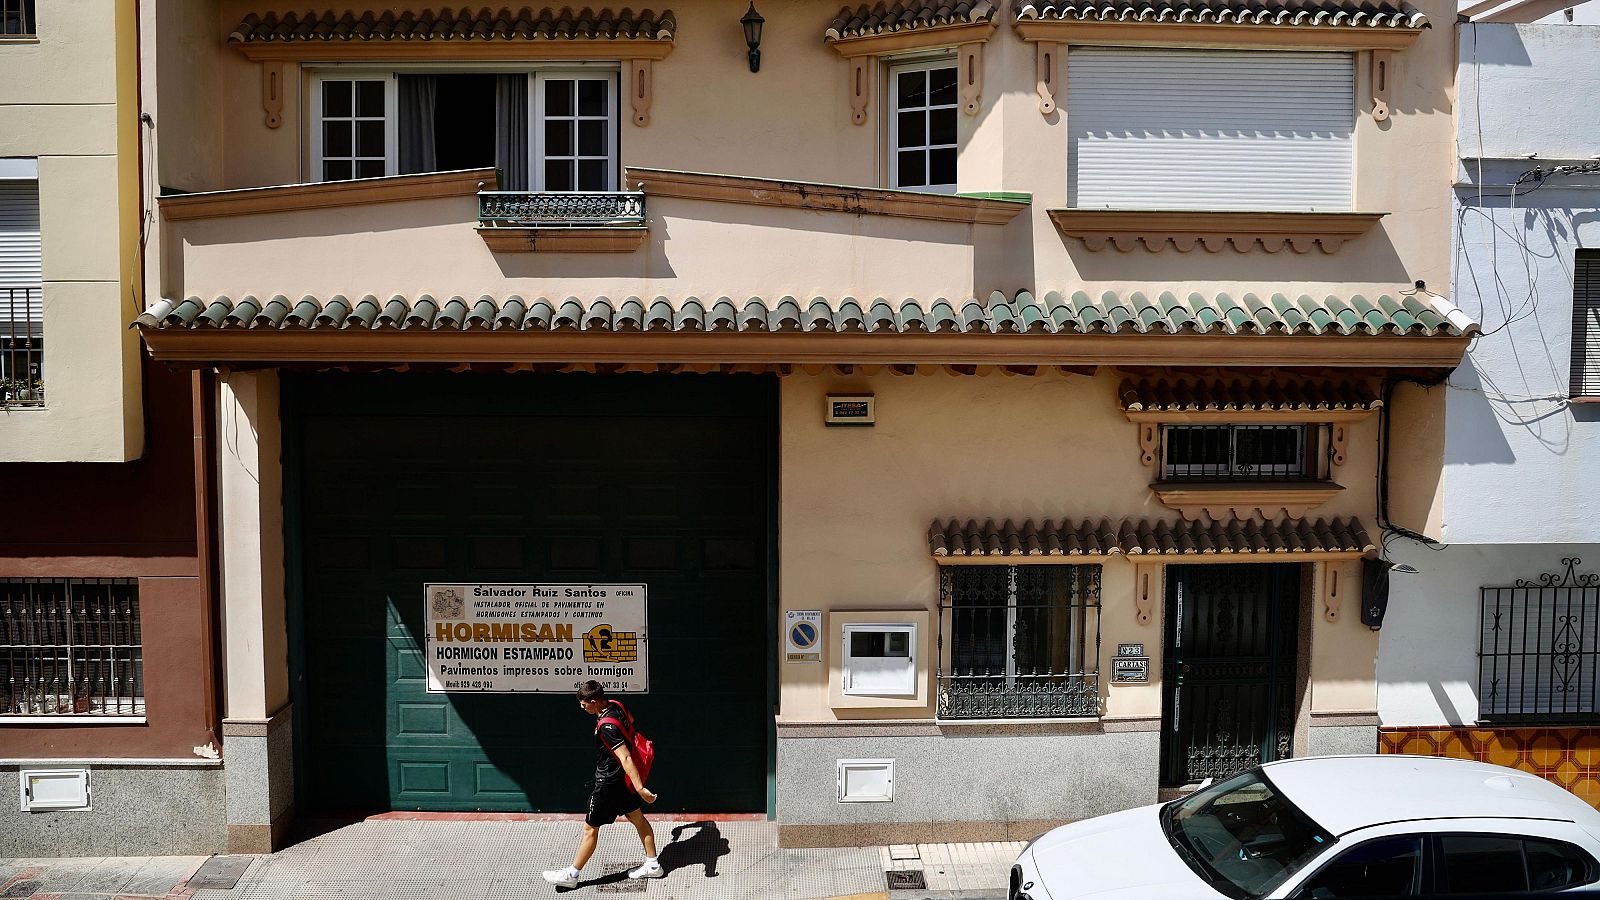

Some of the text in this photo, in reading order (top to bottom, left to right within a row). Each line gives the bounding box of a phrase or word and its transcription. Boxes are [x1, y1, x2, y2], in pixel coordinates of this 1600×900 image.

[473, 588, 607, 598] Salvador Ruiz Santos
[473, 601, 511, 609] INSTALADOR
[553, 601, 593, 609] PAVIMENTOS
[596, 601, 605, 609] EN
[435, 622, 574, 643] HORMISAN
[436, 647, 574, 661] HORMIGON ESTAMPADO
[440, 664, 634, 678] Pavimentos impresos sobre hormigon
